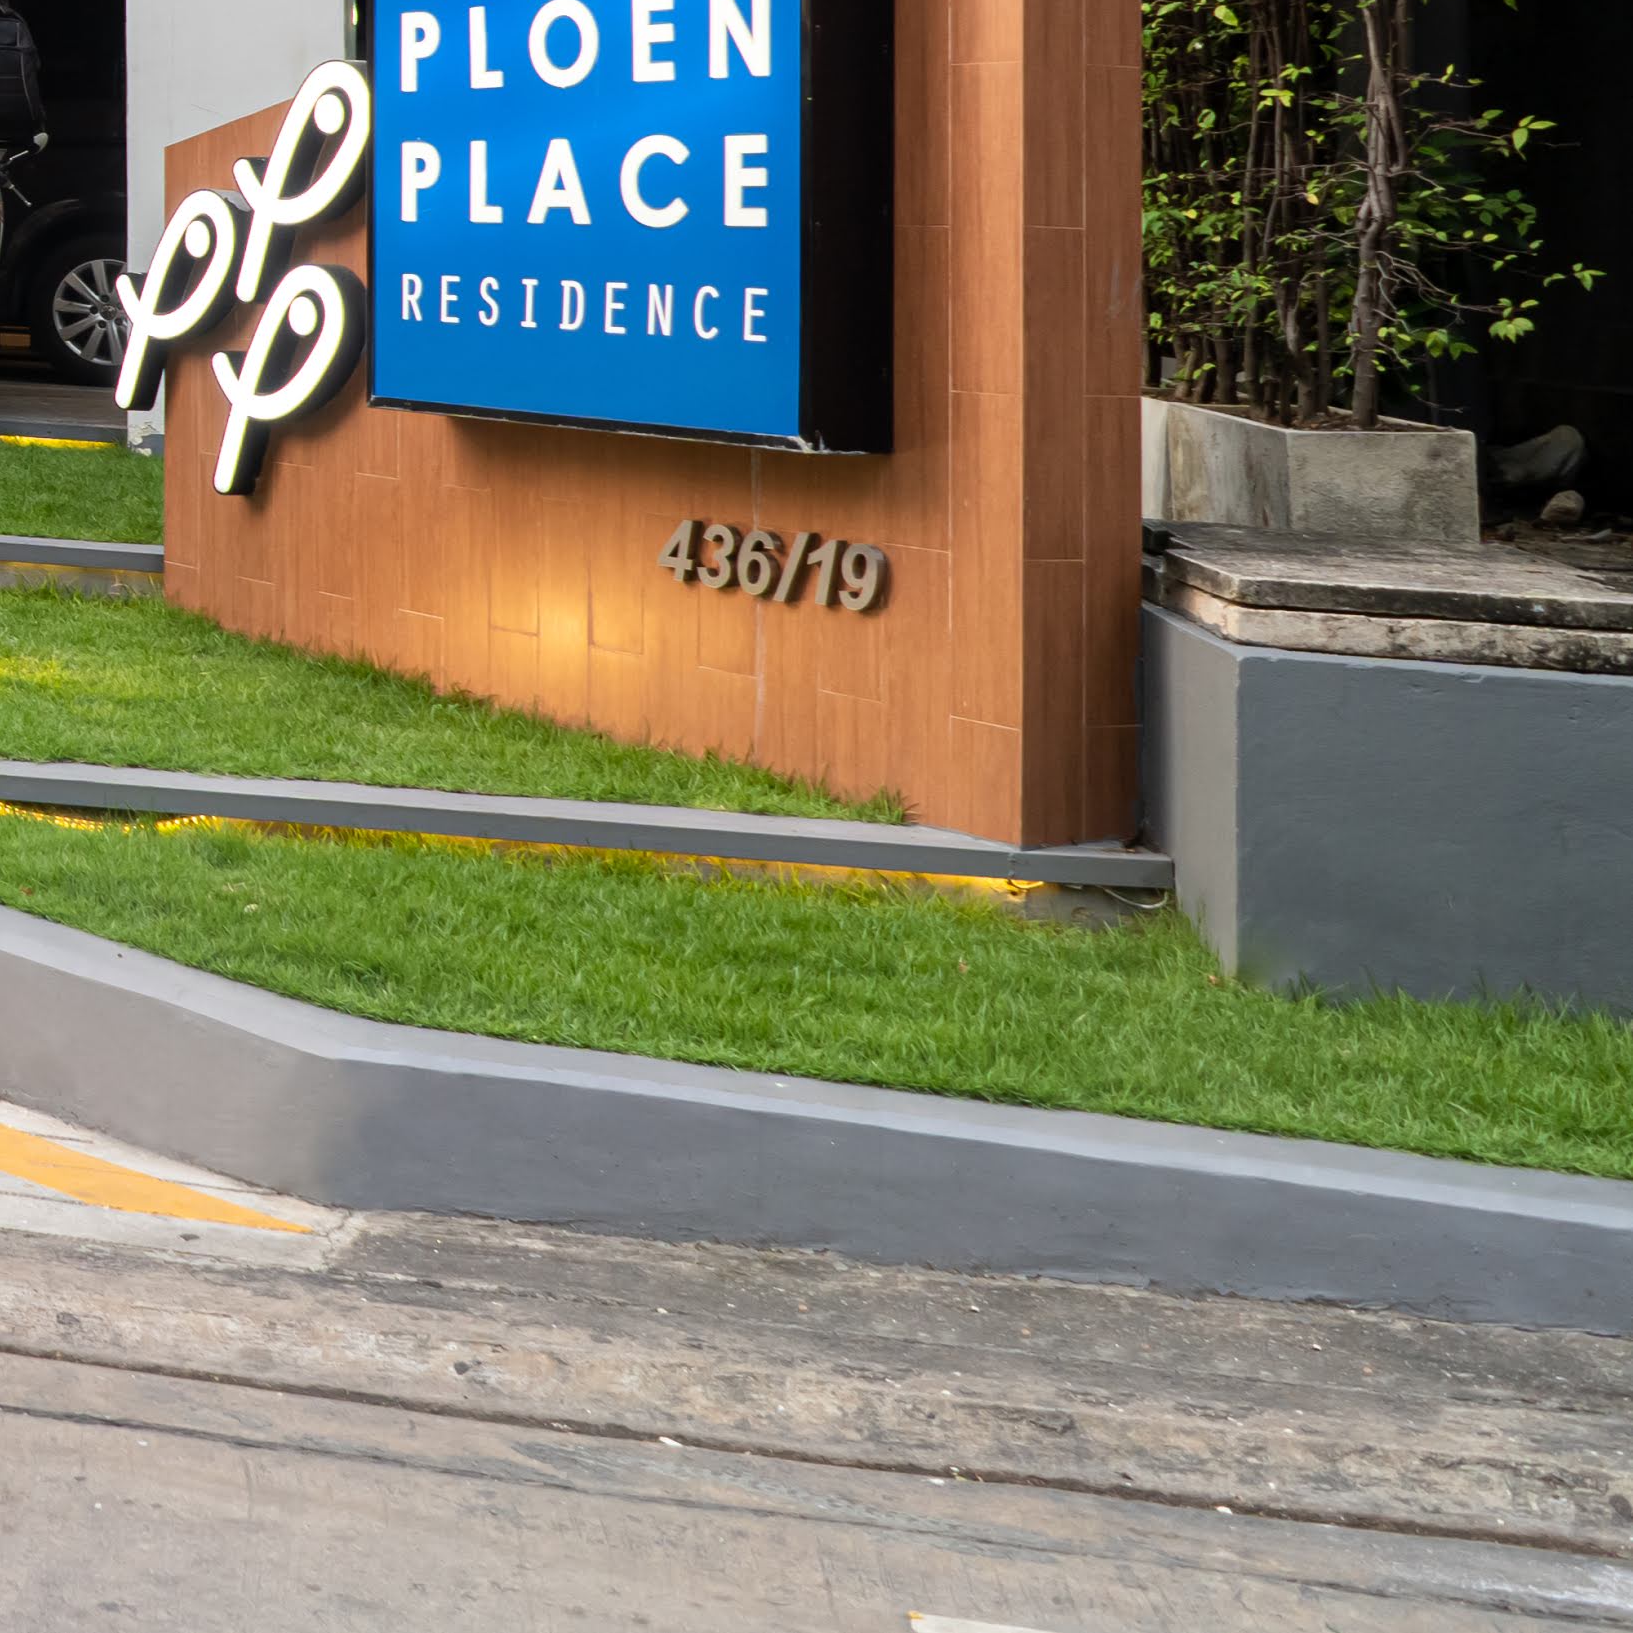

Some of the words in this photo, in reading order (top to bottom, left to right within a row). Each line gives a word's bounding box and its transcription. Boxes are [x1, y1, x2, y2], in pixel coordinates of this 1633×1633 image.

[401, 134, 769, 228] PLACE
[401, 273, 768, 342] RESIDENCE
[657, 519, 883, 611] 436/19
